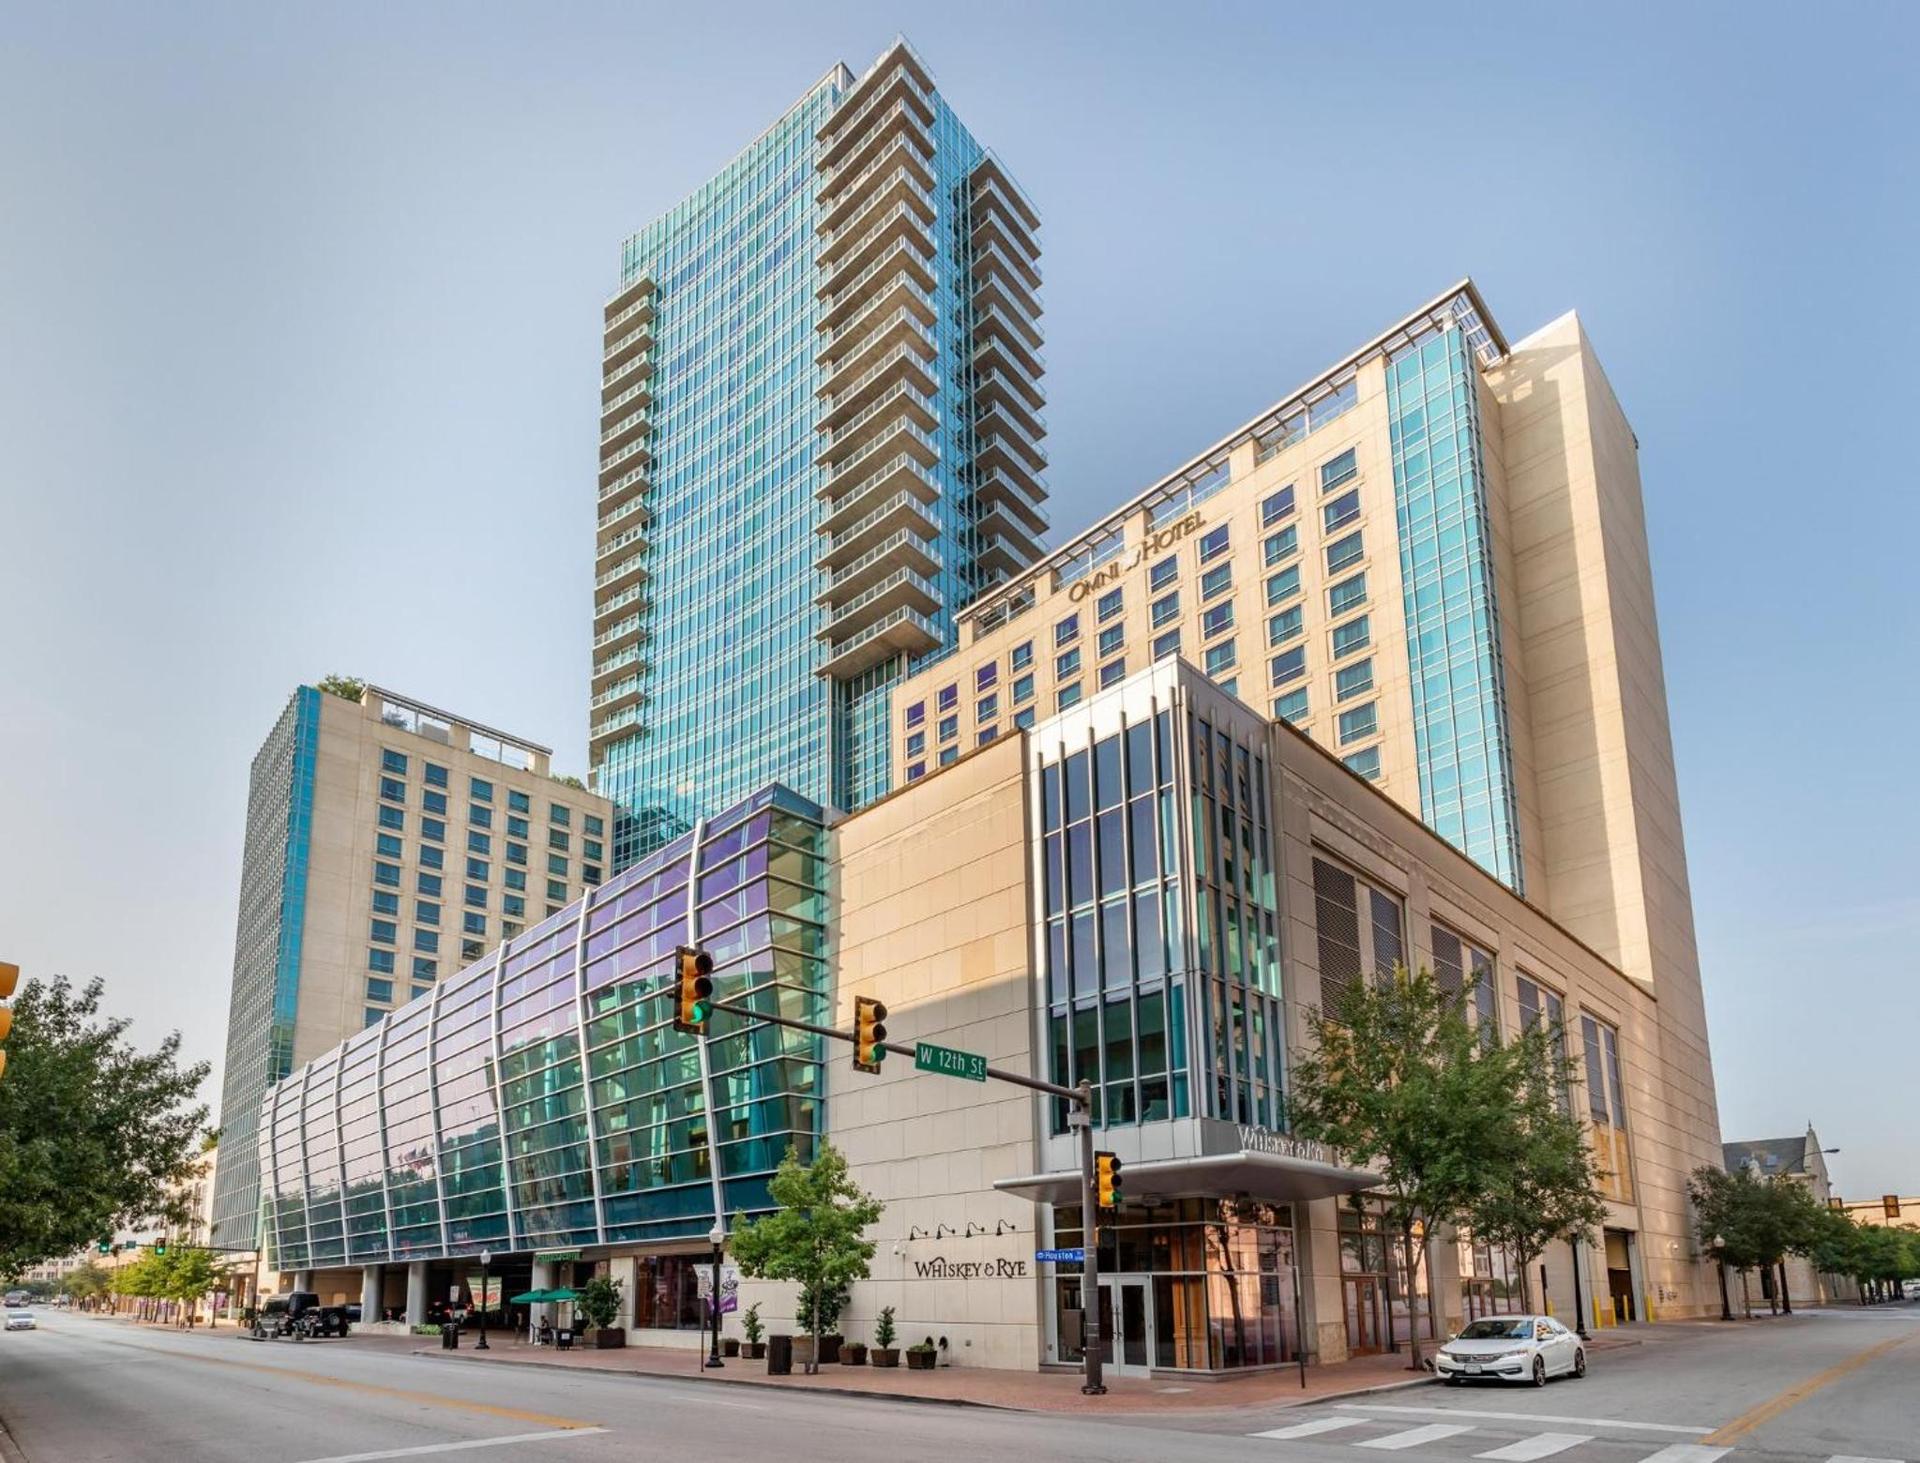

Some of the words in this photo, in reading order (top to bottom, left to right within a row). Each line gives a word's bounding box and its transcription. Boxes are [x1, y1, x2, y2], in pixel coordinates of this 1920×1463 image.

[1068, 561, 1120, 602] OMNI
[1142, 510, 1207, 561] HOTEL
[920, 1046, 933, 1064] W
[939, 1050, 965, 1071] 12th
[970, 1057, 983, 1075] St
[914, 1256, 982, 1279] WHISKEY
[984, 1263, 994, 1277] &
[996, 1258, 1027, 1279] RYE
[1045, 1251, 1074, 1260] Houston
